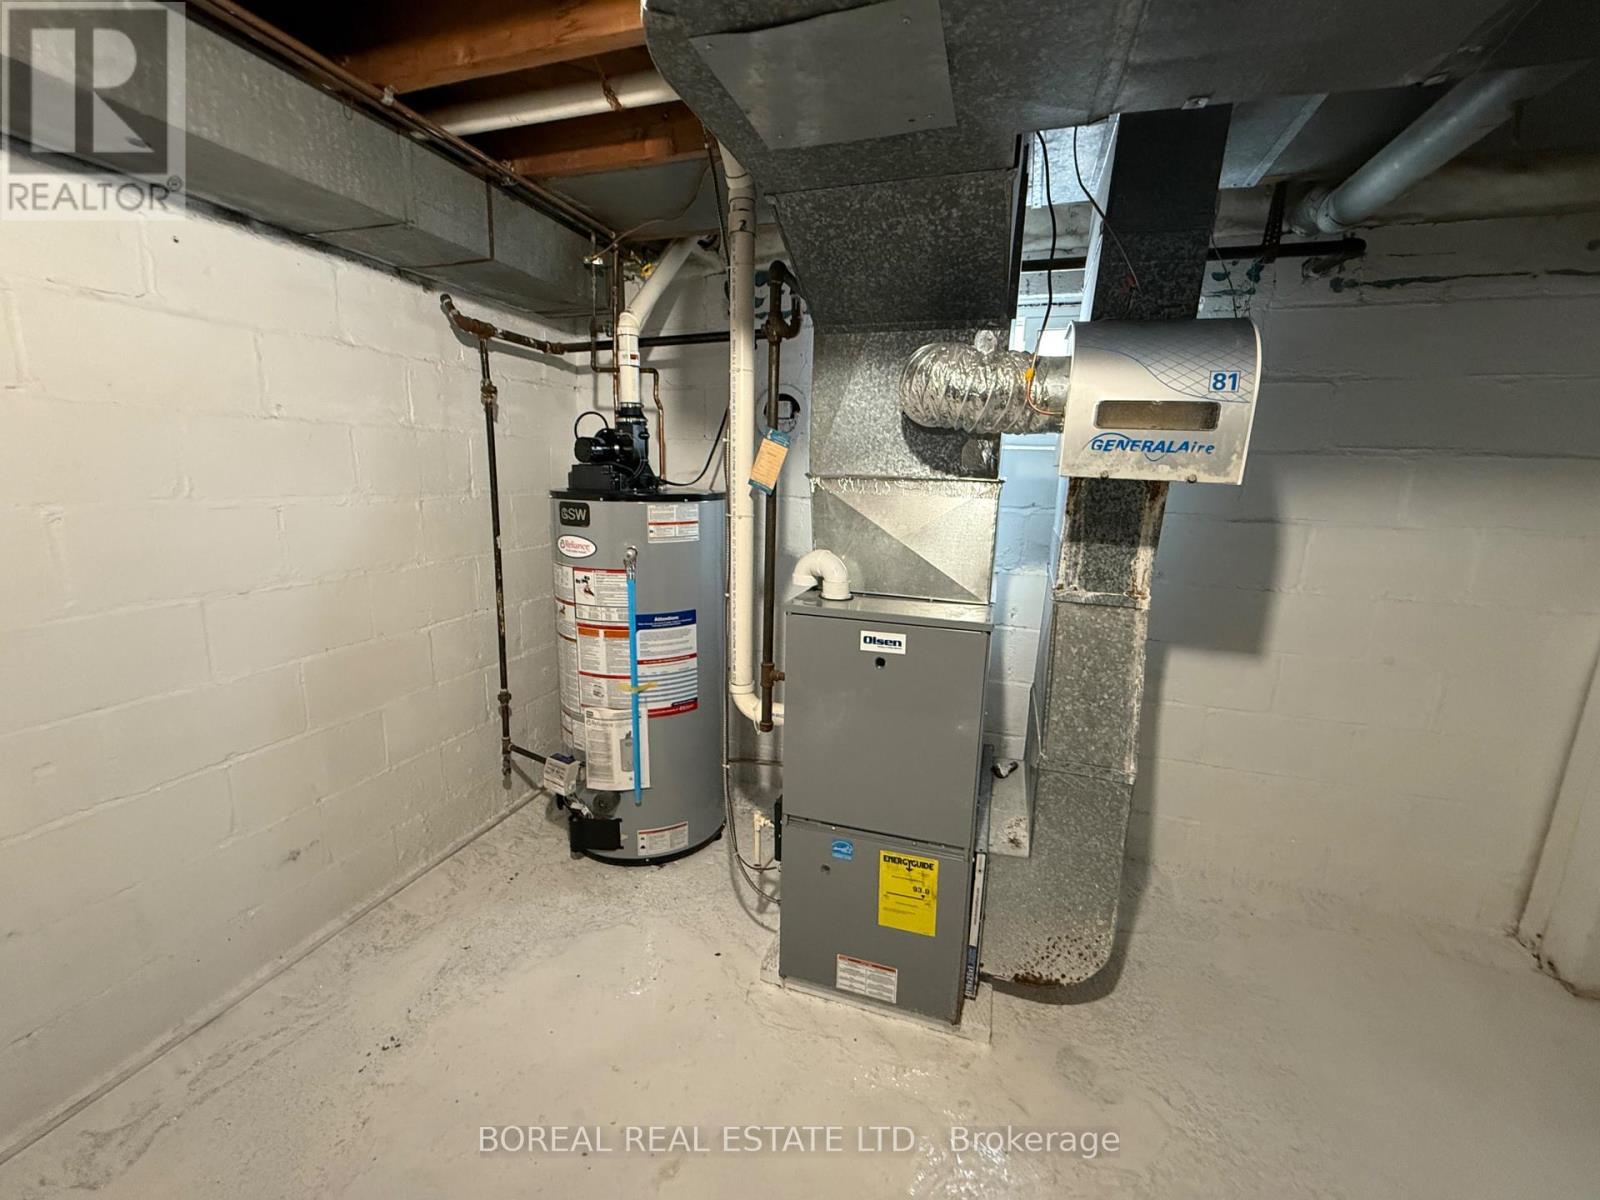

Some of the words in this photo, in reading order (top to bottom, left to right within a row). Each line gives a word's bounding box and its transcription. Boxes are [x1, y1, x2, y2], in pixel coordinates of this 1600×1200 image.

[1212, 373, 1238, 390] 81
[1091, 439, 1215, 455] GENERALAire
[561, 507, 587, 520] GSW
[863, 635, 902, 648] Olsen
